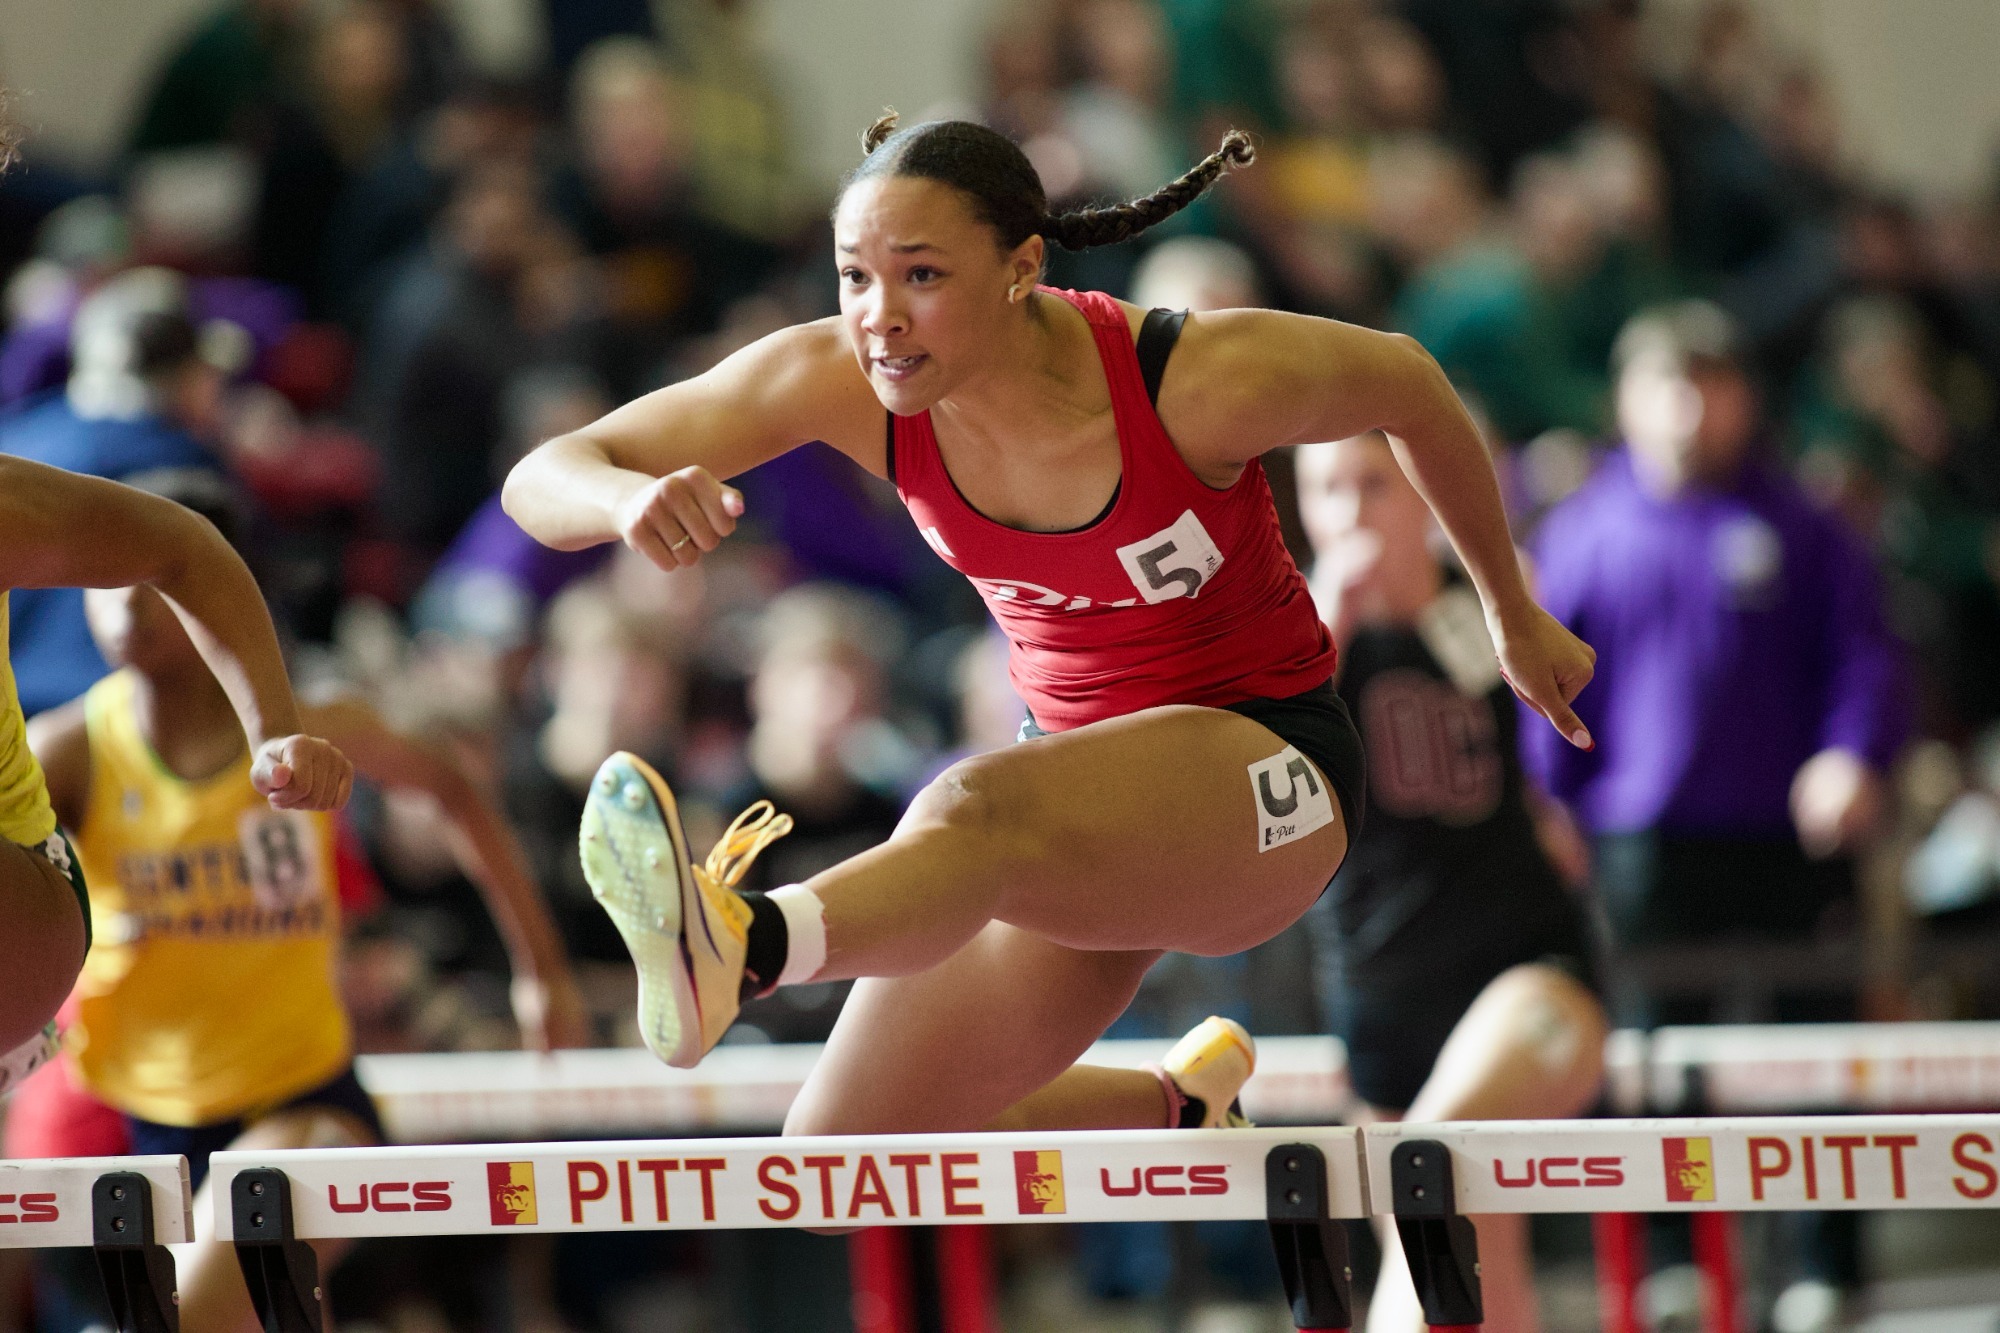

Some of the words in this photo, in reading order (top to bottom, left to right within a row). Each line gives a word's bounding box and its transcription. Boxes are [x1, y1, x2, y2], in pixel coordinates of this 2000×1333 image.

[1135, 540, 1203, 598] 5
[1258, 755, 1320, 818] 5
[256, 815, 307, 888] 8
[1276, 824, 1296, 840] Pitt
[328, 1182, 452, 1213] UCS
[565, 1156, 728, 1225] PITT
[756, 1151, 986, 1222] STATE
[1100, 1164, 1230, 1197] UCS
[1493, 1156, 1625, 1188] UCS
[1746, 1133, 1919, 1202] PITT
[1950, 1131, 2000, 1200] S
